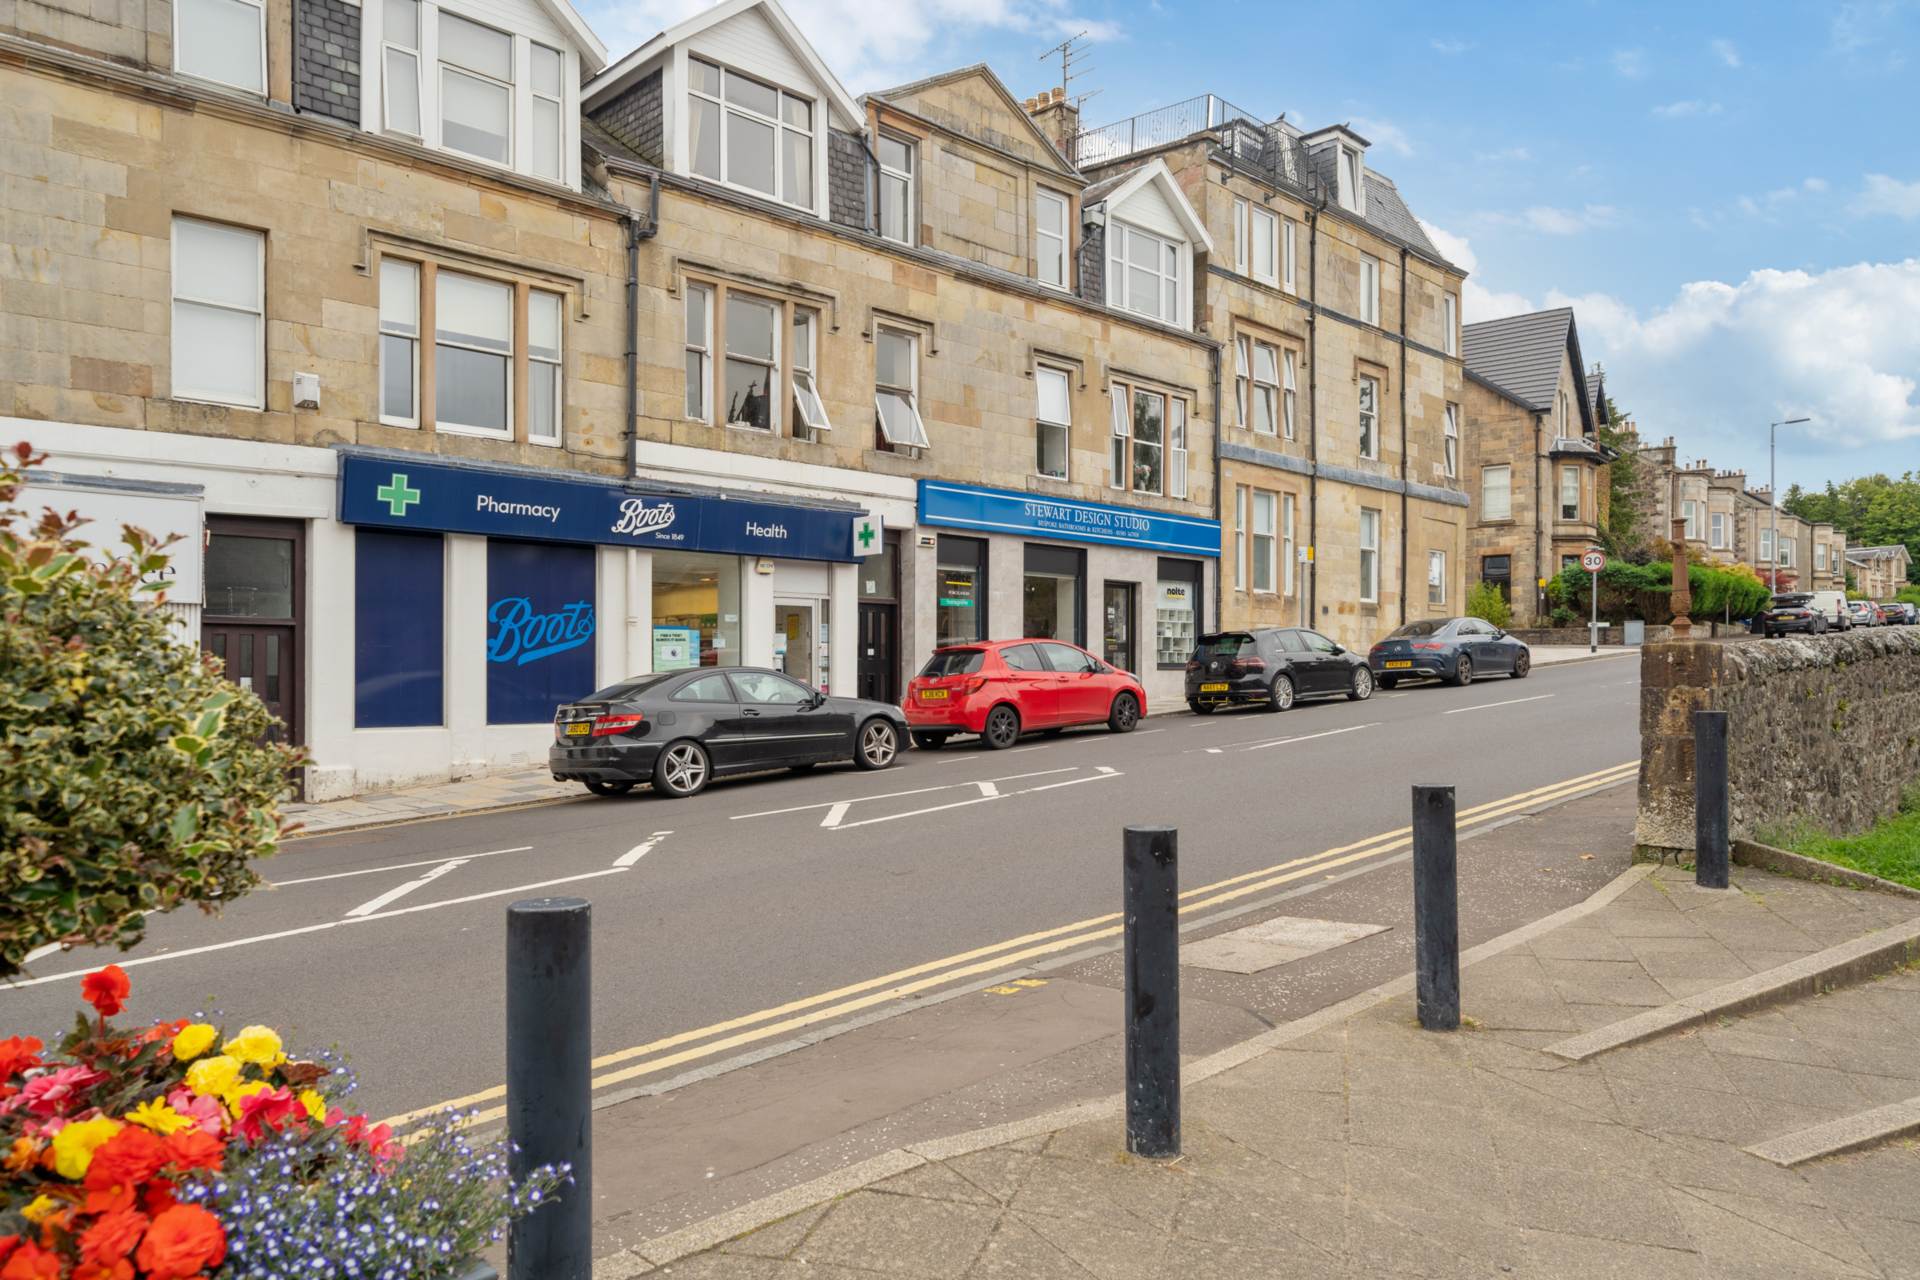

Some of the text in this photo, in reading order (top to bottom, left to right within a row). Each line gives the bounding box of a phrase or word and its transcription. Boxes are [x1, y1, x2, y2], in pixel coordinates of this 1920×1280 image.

[476, 494, 561, 523] Pharmacy
[610, 498, 676, 536] Boots
[1024, 504, 1150, 531] STEWART DESIGN STUDIO
[745, 521, 788, 539] Health
[1038, 520, 1057, 528] BESPOKE
[655, 531, 685, 542] Since 1849
[1585, 557, 1601, 566] 30
[1166, 587, 1185, 596] nolte
[486, 596, 596, 667] Boots
